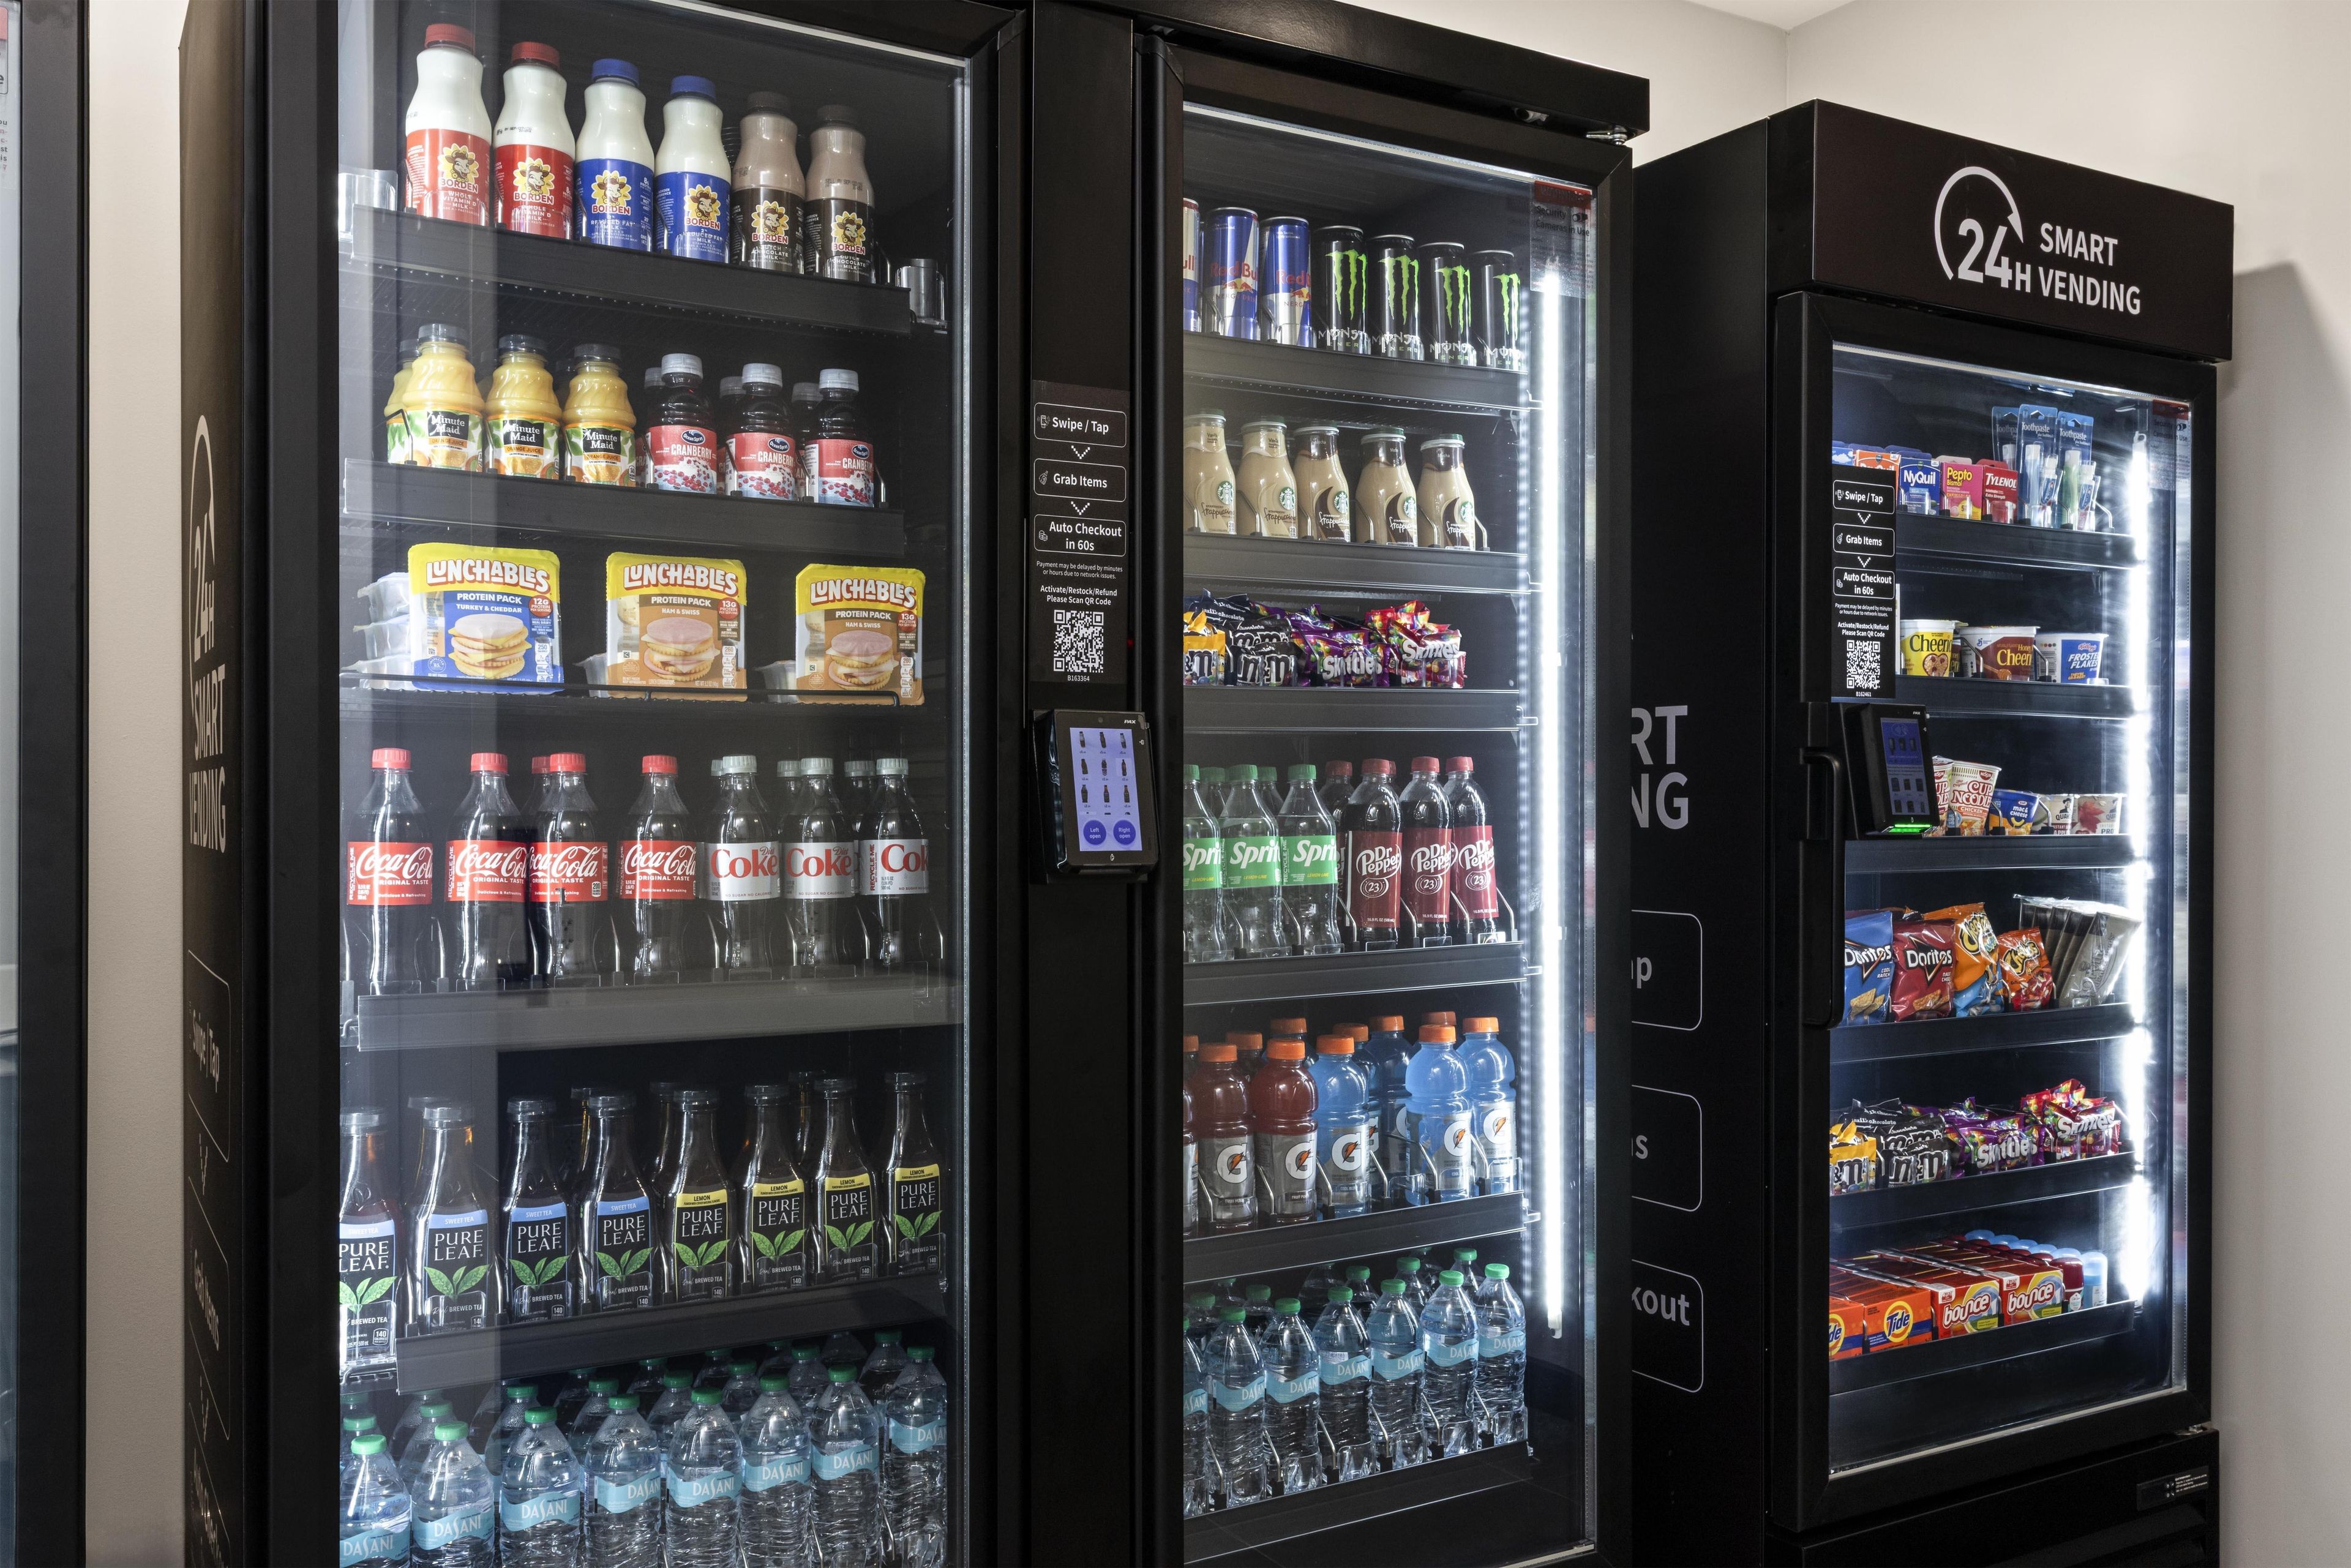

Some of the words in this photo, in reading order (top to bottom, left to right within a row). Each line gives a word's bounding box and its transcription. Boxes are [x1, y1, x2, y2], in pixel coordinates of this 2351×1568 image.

[441, 179, 478, 192] BORDEN
[514, 193, 553, 204] BORDEN
[686, 219, 720, 230] BORDEN
[752, 234, 788, 244] BORDEN
[2040, 223, 2118, 266] SMART
[833, 244, 865, 254] BORDEN
[1958, 218, 2031, 293] 24H
[2039, 267, 2140, 315] VENDING
[506, 424, 540, 435] Minute
[1052, 418, 1082, 432] Swipe
[1085, 420, 1089, 432] /
[1091, 421, 1109, 435] Tap
[2022, 422, 2050, 433] Toothpaste
[511, 432, 536, 443] Maid
[587, 432, 617, 442] Minute
[2060, 429, 2087, 440] Toothpaste
[590, 440, 614, 449] Maid
[671, 445, 711, 459] CRANBERRY
[758, 451, 793, 465] CRANBERRY
[842, 458, 872, 471] CRANBERRY
[1054, 474, 1077, 486] Grab
[1080, 476, 1107, 488] Items
[1904, 470, 1935, 486] NyQuil
[1947, 467, 1973, 481] Pepto
[1985, 473, 2016, 488] TYLENOL
[1845, 491, 1865, 502] Swipe
[1867, 493, 1870, 503] /
[1871, 494, 1883, 504] Tap
[1049, 522, 1073, 533] Auto
[1076, 523, 1122, 537] Checkout
[1066, 539, 1074, 549] in
[1078, 540, 1094, 550] 60s
[1846, 535, 1862, 544] Grab
[1864, 537, 1882, 546] Items
[426, 559, 550, 594] LUNCHABLES
[624, 563, 738, 597] LUNCHABLES
[1843, 572, 1859, 581] Auto
[1861, 574, 1891, 583] Checkout
[810, 579, 917, 609] LUNCHABLES
[1040, 585, 1117, 596] Activate/Restock/Refund
[1862, 586, 1873, 595] 60s
[497, 595, 522, 604] PACK
[688, 598, 711, 607] PACK
[195, 664, 225, 760] SMART
[1968, 781, 1993, 795] CUP
[189, 766, 225, 853] VENDING
[869, 844, 874, 854] ME
[1230, 839, 1280, 869] Sprit
[1375, 846, 1392, 858] Dr
[711, 849, 778, 878] Coke
[787, 848, 852, 877] Coke
[1362, 850, 1400, 876] Pepper
[1368, 882, 1379, 892] 23
[1845, 946, 1891, 966] Doritos
[1907, 950, 1952, 967] Doritos
[1332, 1133, 1363, 1171] G
[1217, 1142, 1247, 1184] G
[901, 1182, 936, 1196] PURE
[759, 1198, 800, 1213] PURE
[901, 1194, 936, 1209] LEAF
[682, 1208, 722, 1223] PURE
[759, 1211, 799, 1226] LEAF
[518, 1223, 561, 1239] PURE
[604, 1215, 645, 1232] PURE
[682, 1221, 722, 1237] LEAF
[435, 1230, 483, 1247] PURE
[518, 1237, 560, 1253] LEAF
[604, 1229, 645, 1246] LEAF
[434, 1245, 483, 1261] LEAF
[2008, 1285, 2054, 1313] bounce
[1943, 1295, 1989, 1327] bounce
[1886, 1310, 1910, 1338] Tide
[834, 1451, 872, 1469] DASANI
[693, 1477, 734, 1498] DASANI
[435, 1516, 481, 1539] DASANI
